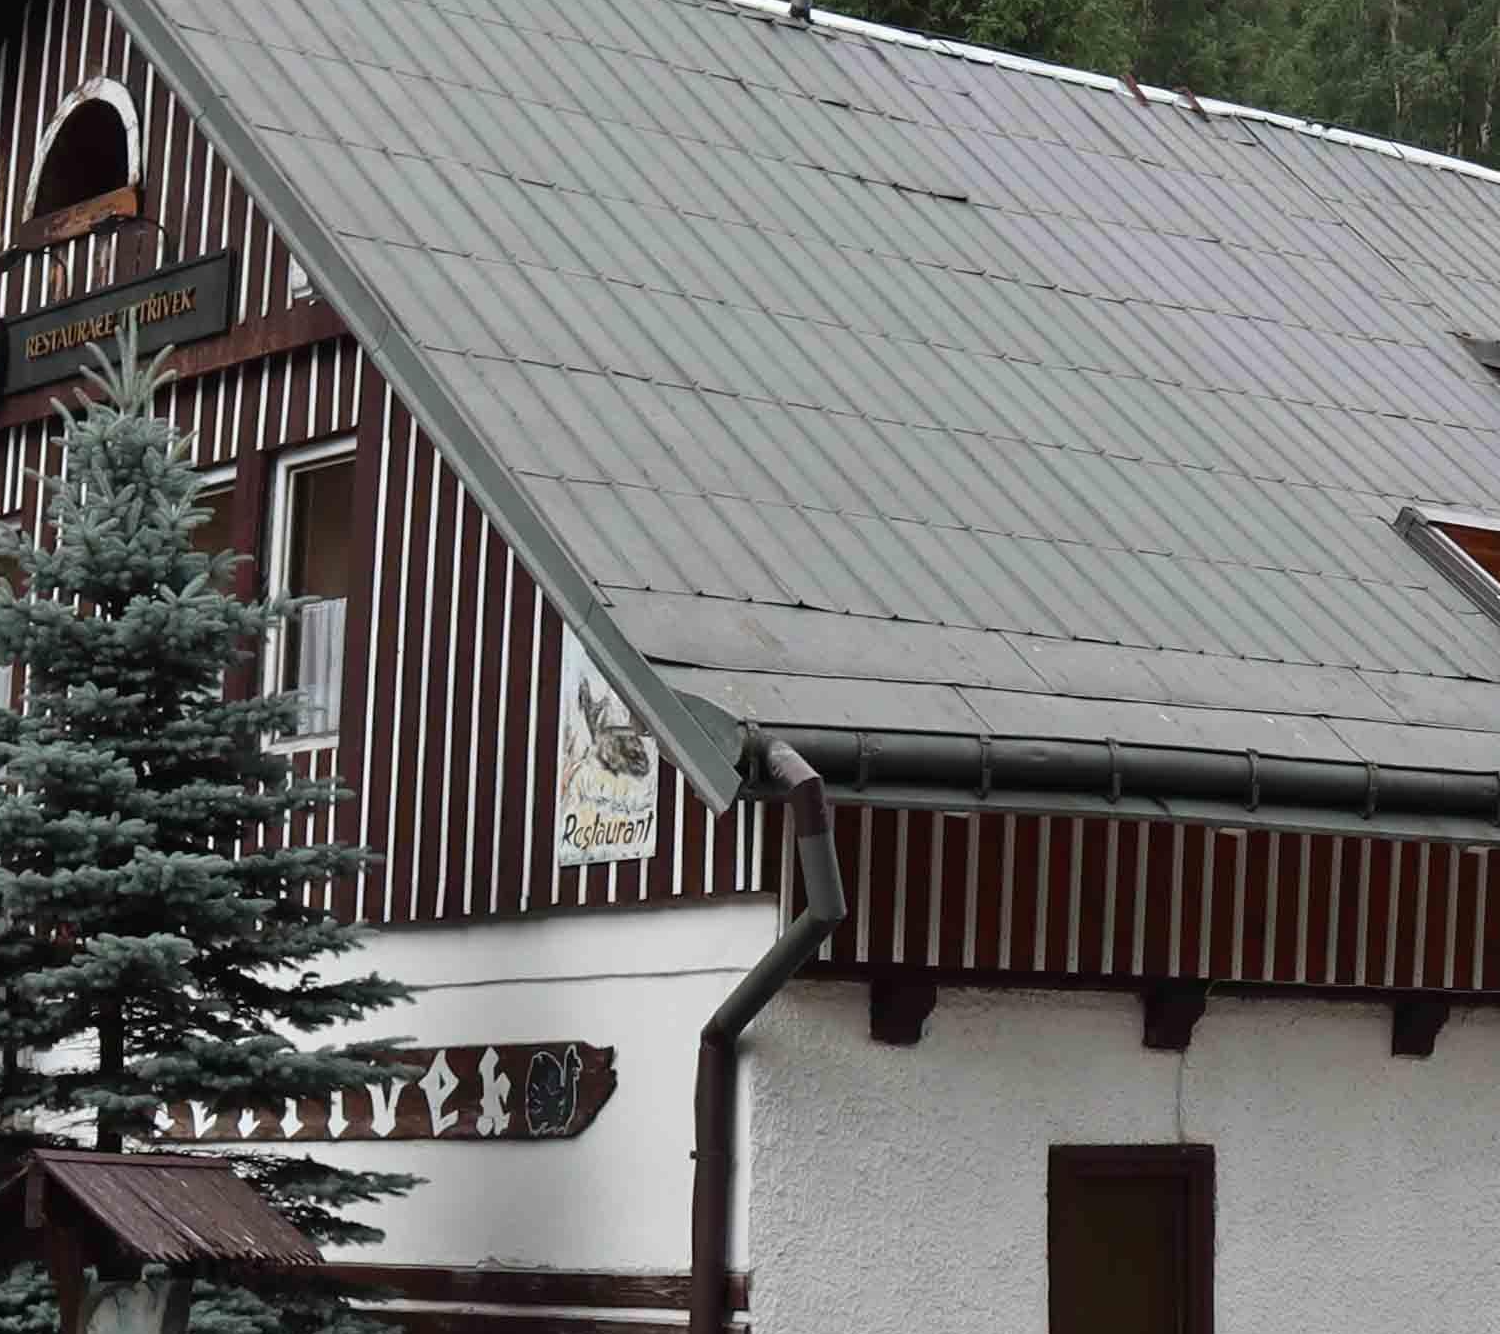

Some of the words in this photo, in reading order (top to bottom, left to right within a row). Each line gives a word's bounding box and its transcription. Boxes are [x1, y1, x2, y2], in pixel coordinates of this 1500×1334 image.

[25, 314, 116, 360] RESTAURACE
[115, 286, 197, 328] TTŘÍVEK
[562, 810, 654, 851] Restaurant
